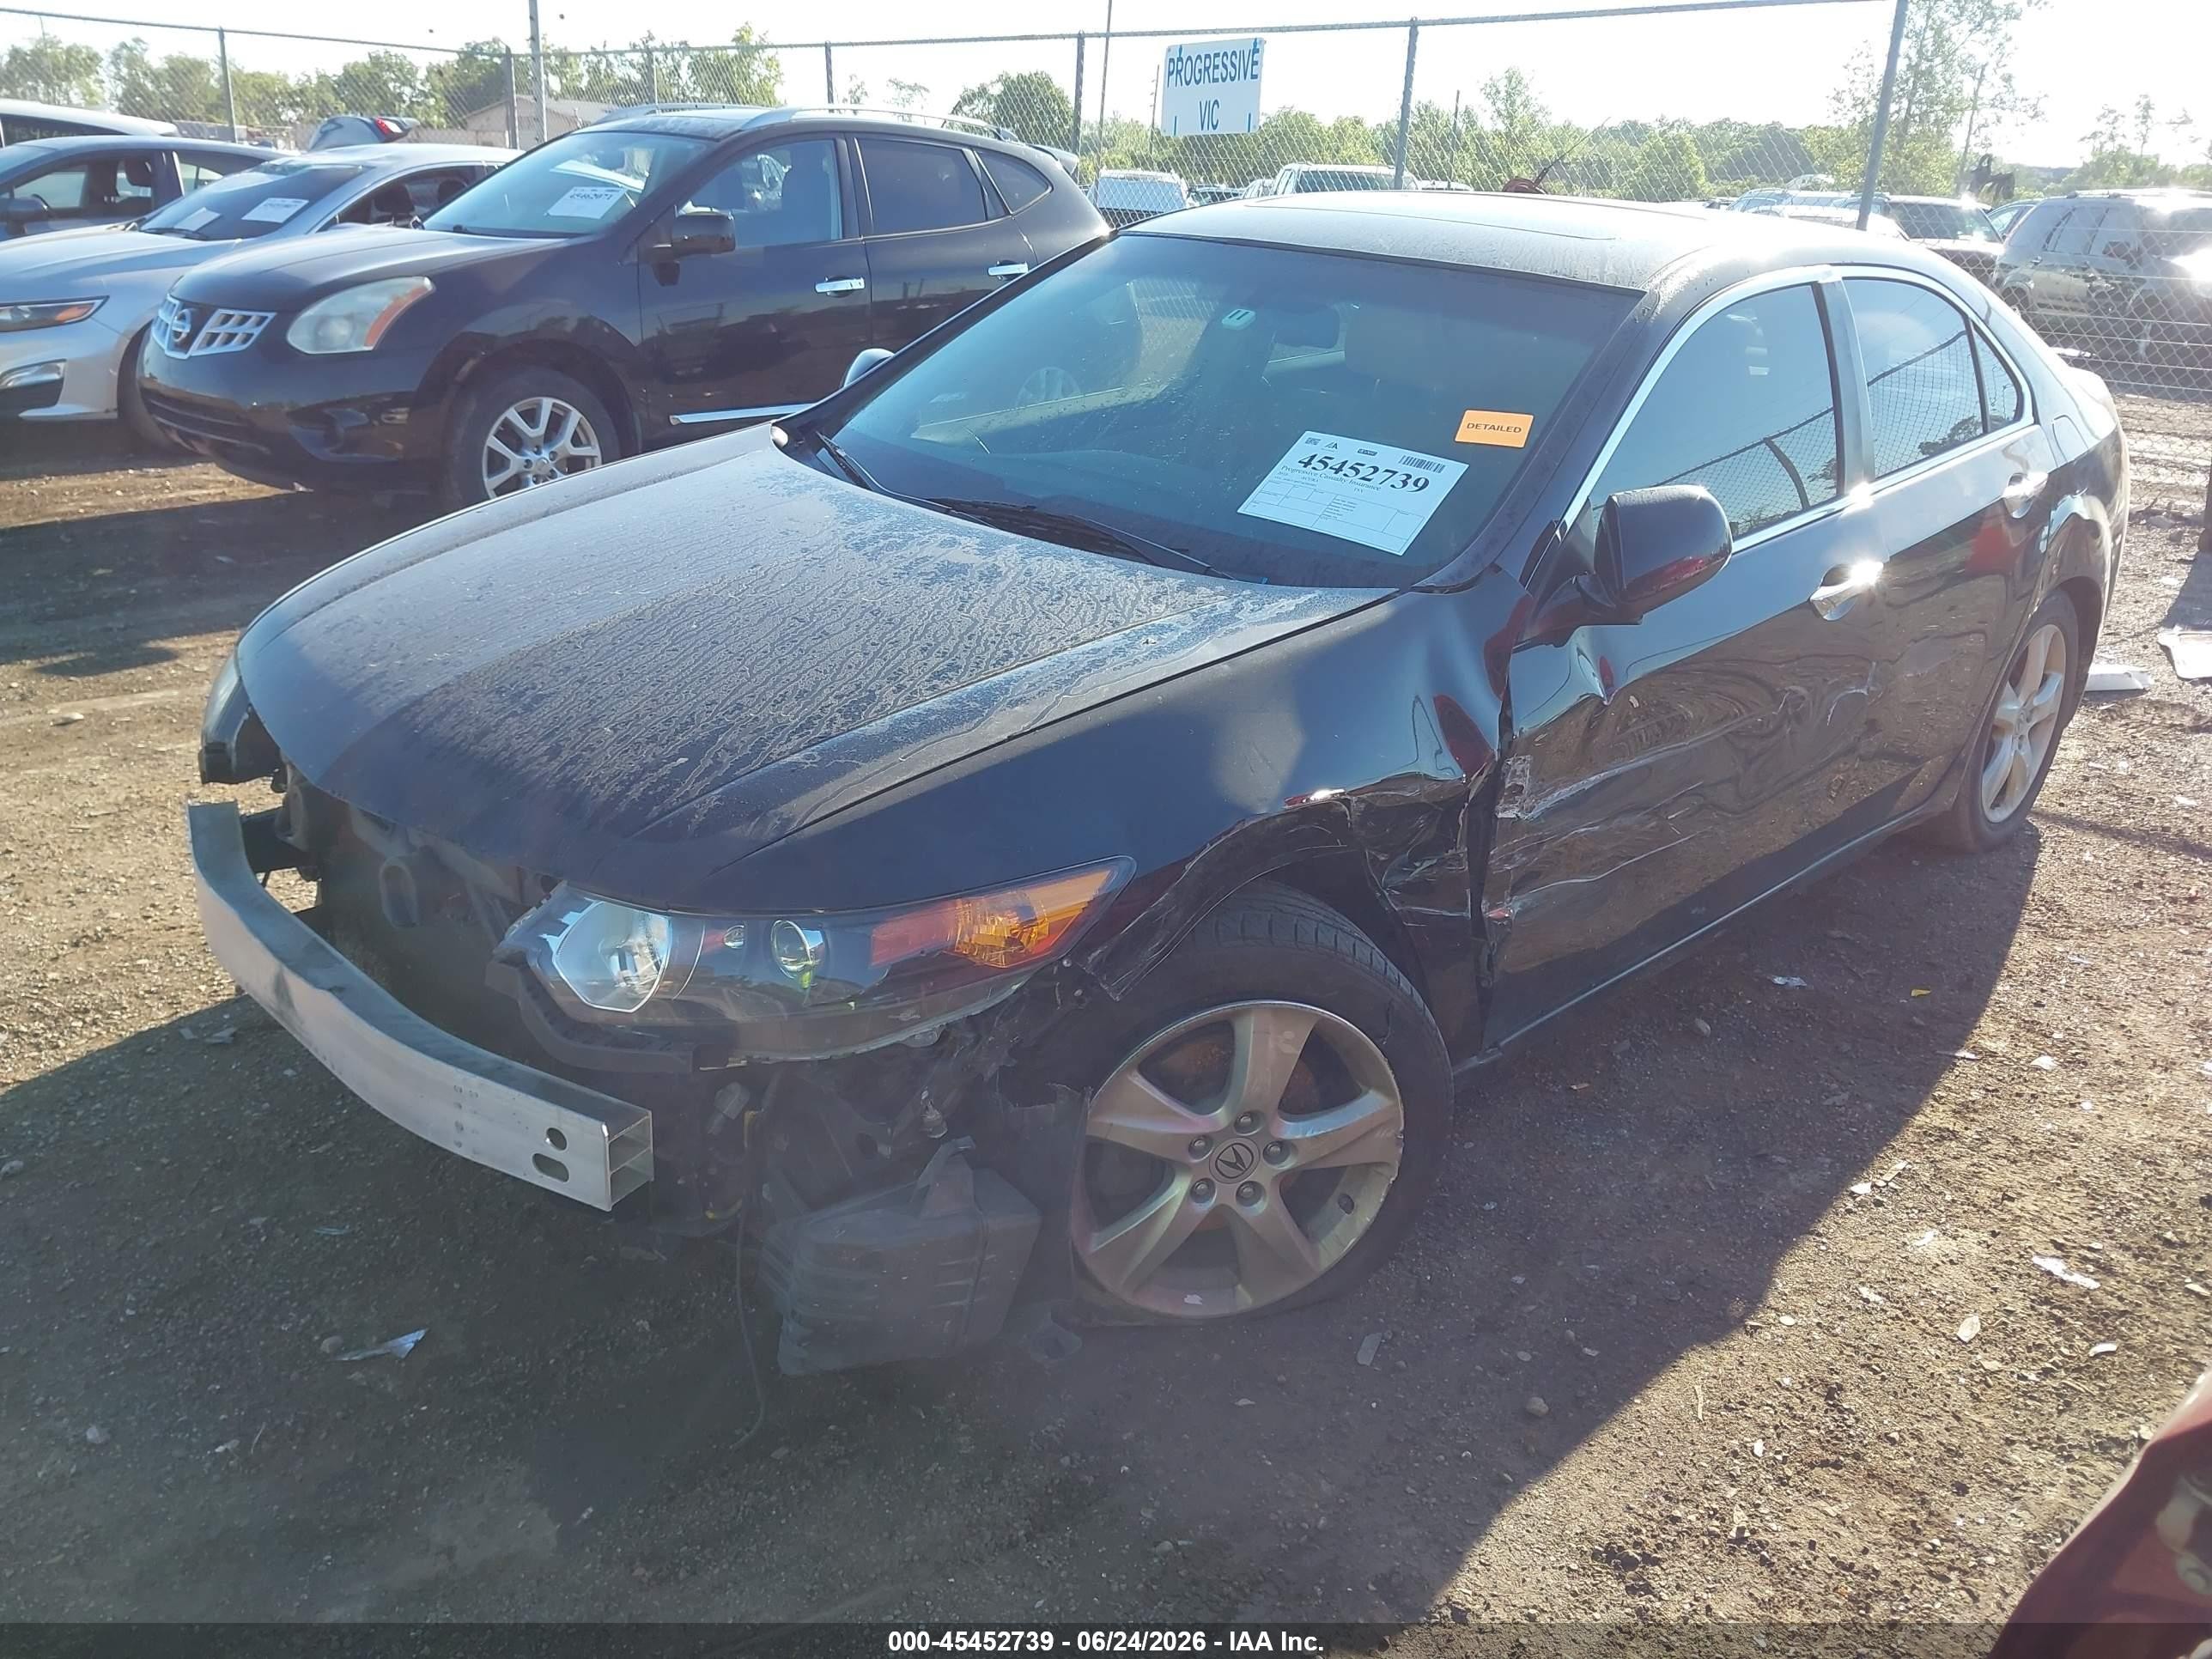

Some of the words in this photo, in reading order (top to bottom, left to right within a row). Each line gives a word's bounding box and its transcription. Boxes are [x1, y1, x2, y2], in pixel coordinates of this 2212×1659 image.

[1167, 48, 1260, 88] PROGRESSIVE
[1200, 99, 1219, 131] VIC
[1467, 422, 1522, 433] DETAILED
[1281, 465, 1318, 477] Progressive
[1319, 472, 1348, 483] Casualty
[1349, 478, 1382, 491] Insurance
[1297, 453, 1430, 493] 45452739
